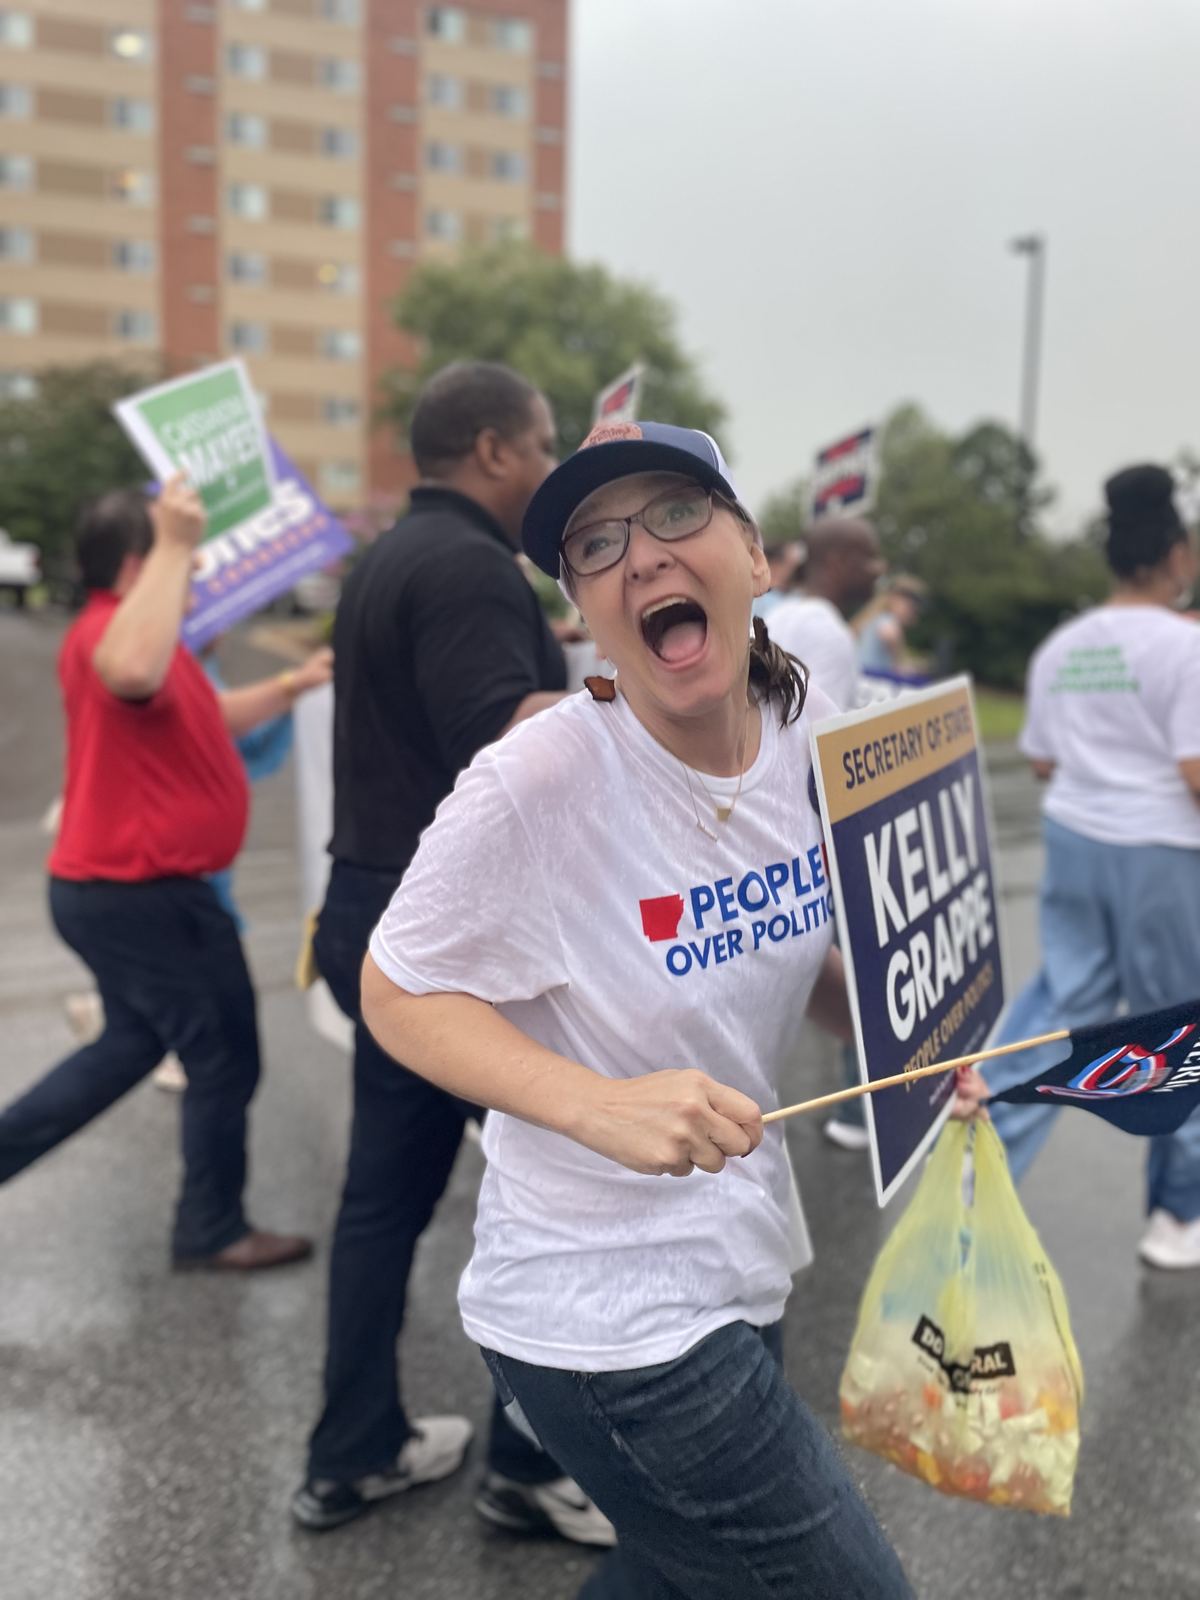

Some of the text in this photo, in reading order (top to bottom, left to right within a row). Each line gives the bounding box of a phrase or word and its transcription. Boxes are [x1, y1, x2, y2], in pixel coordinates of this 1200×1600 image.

[842, 724, 925, 790] SECRETARY
[926, 714, 943, 751] OF
[690, 845, 825, 929] PEOPLE
[864, 774, 980, 949] KELLY
[666, 929, 743, 976] OVER
[886, 870, 994, 1042] GRAPPE
[941, 999, 964, 1044] OVER
